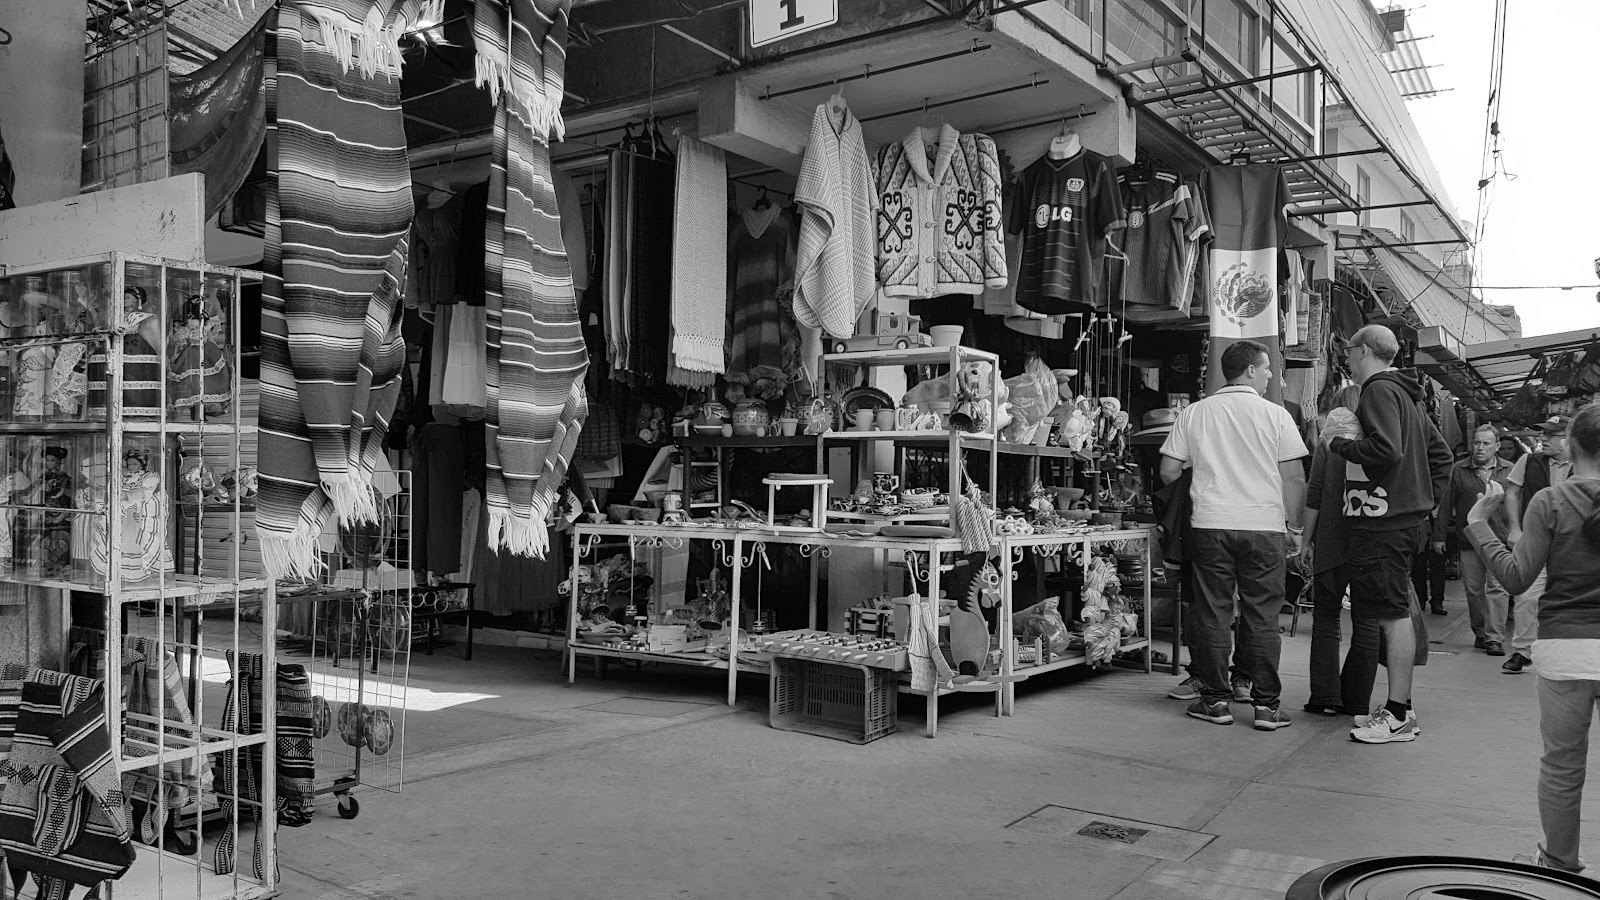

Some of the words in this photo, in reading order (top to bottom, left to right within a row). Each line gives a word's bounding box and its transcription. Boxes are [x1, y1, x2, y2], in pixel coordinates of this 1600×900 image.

[780, 0, 804, 30] 1
[1052, 206, 1073, 222] LG
[1343, 486, 1389, 517] as
